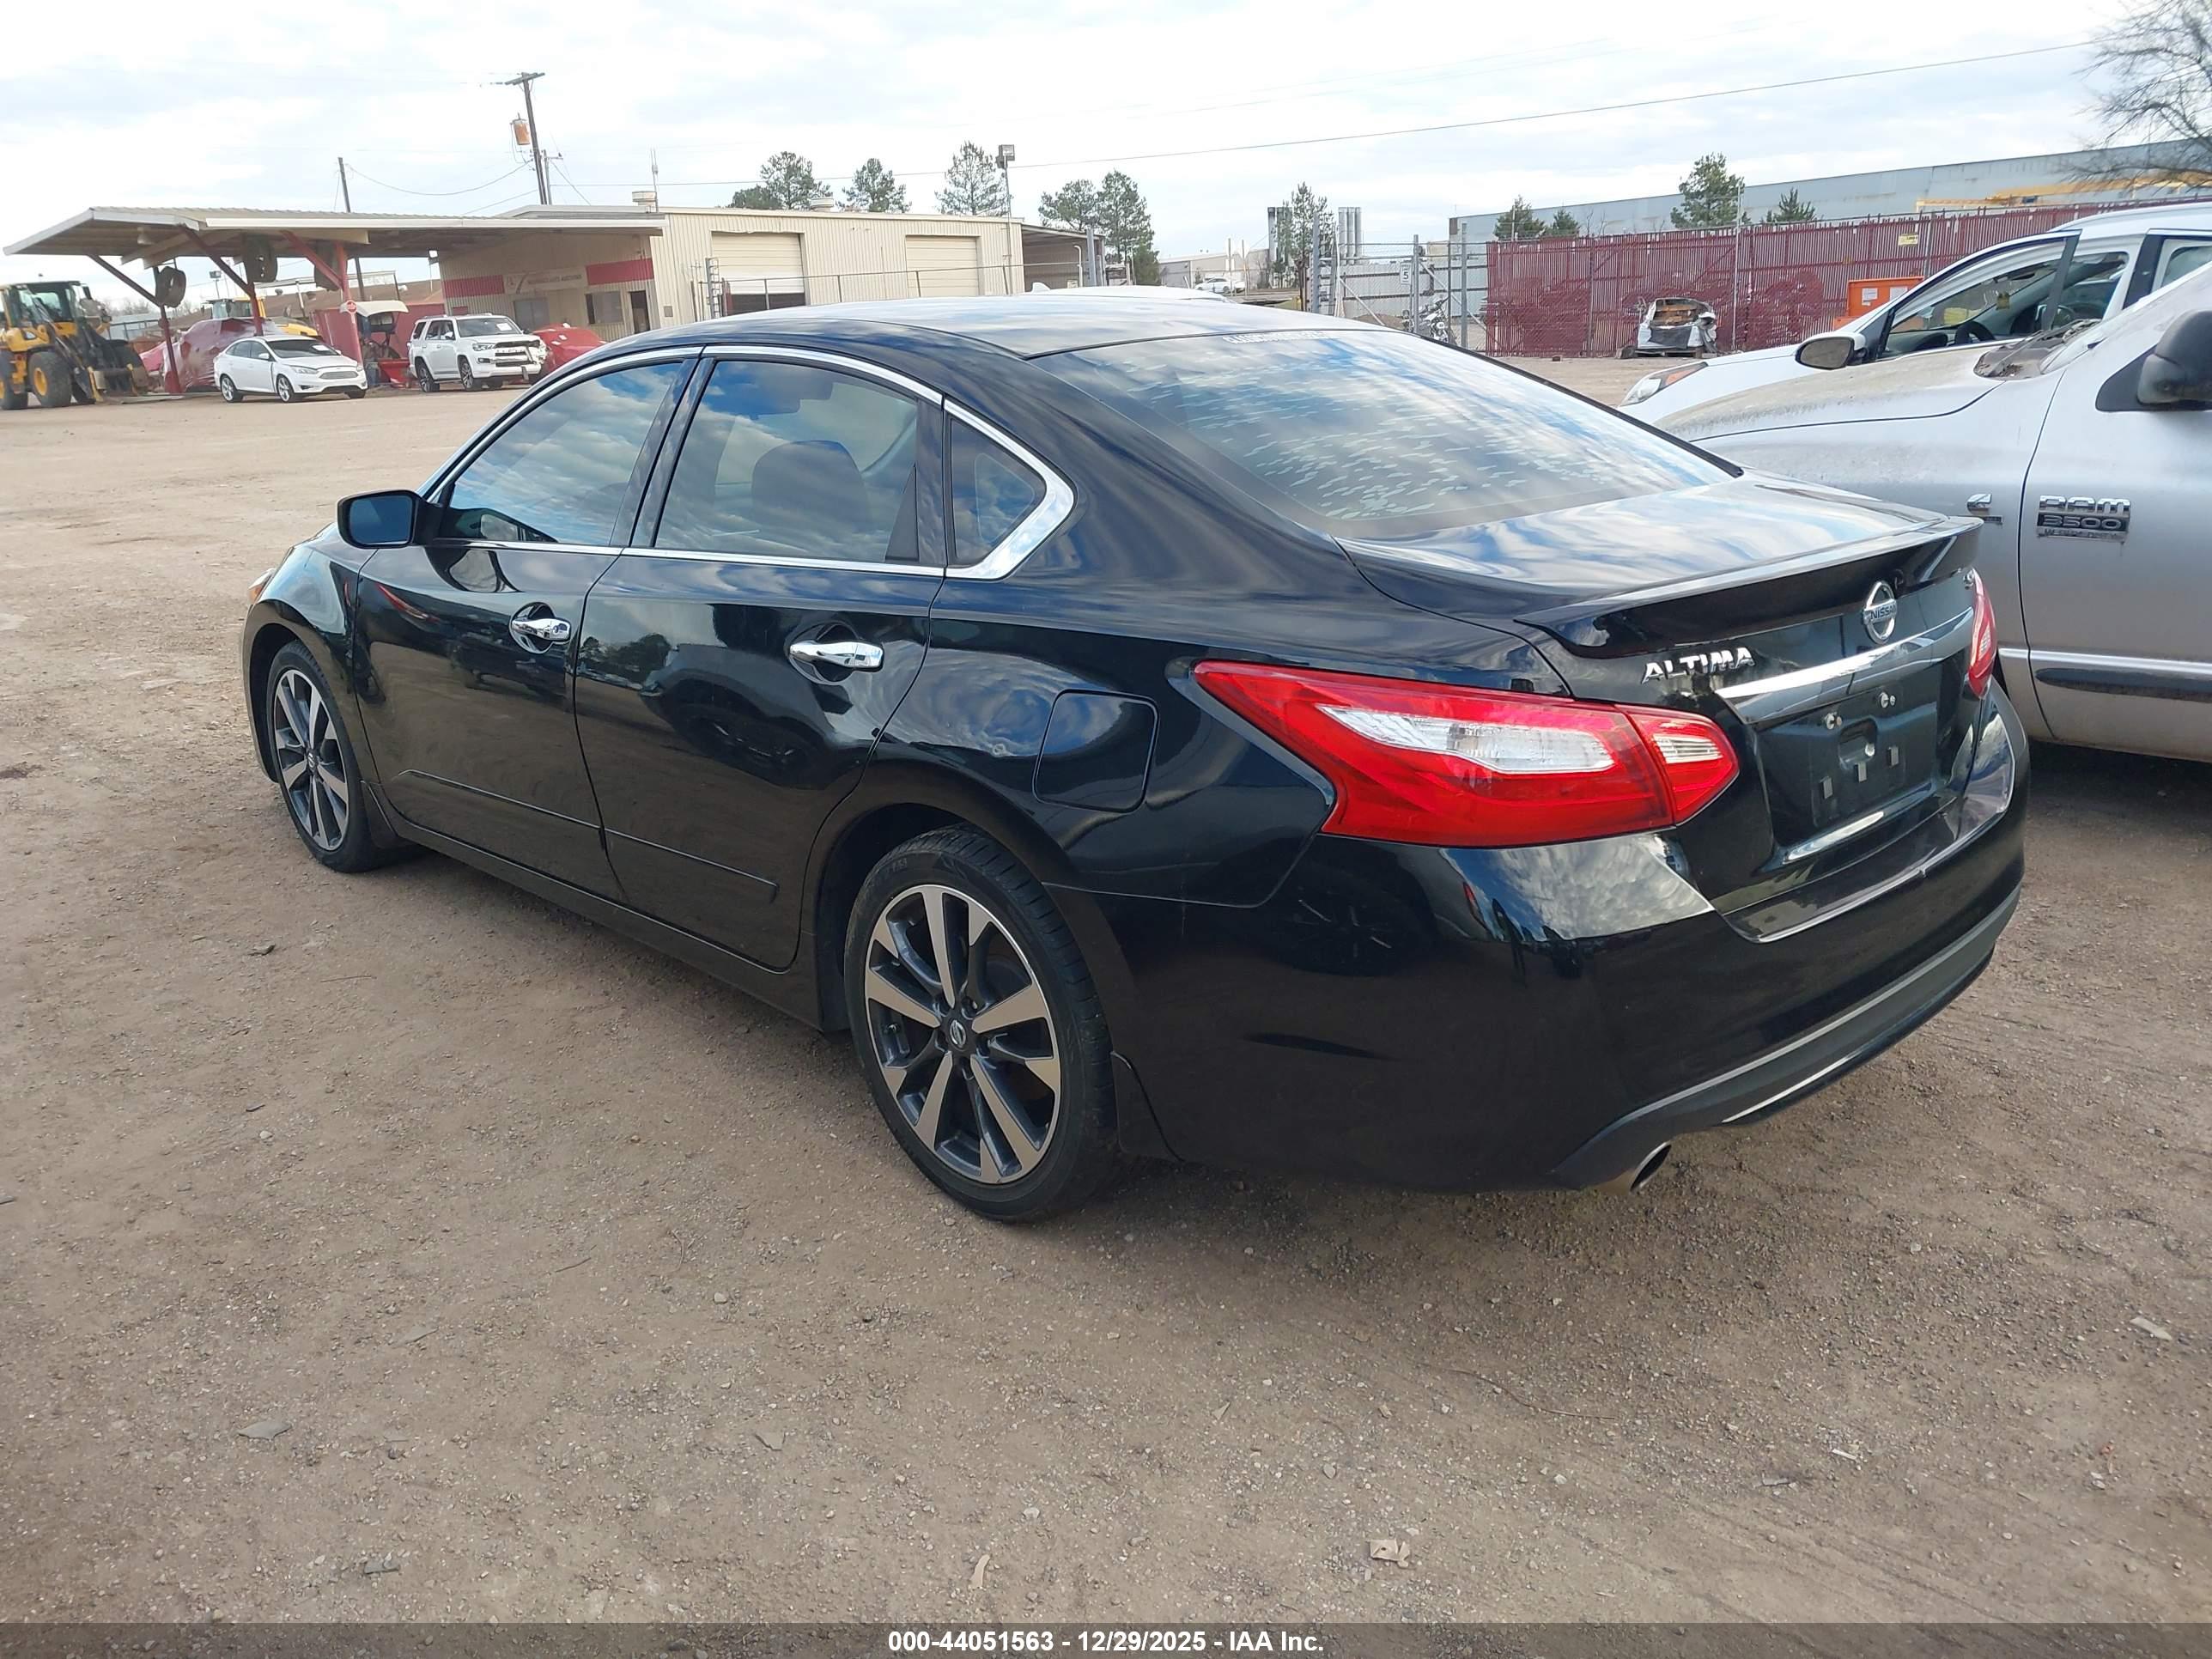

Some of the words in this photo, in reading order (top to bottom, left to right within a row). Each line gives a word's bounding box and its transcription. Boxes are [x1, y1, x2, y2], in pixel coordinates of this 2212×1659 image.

[2039, 495, 2130, 514] RAM
[2043, 514, 2122, 530] 3500
[1870, 604, 1896, 620] NISSAN
[1641, 647, 1756, 684] ALTIMA
